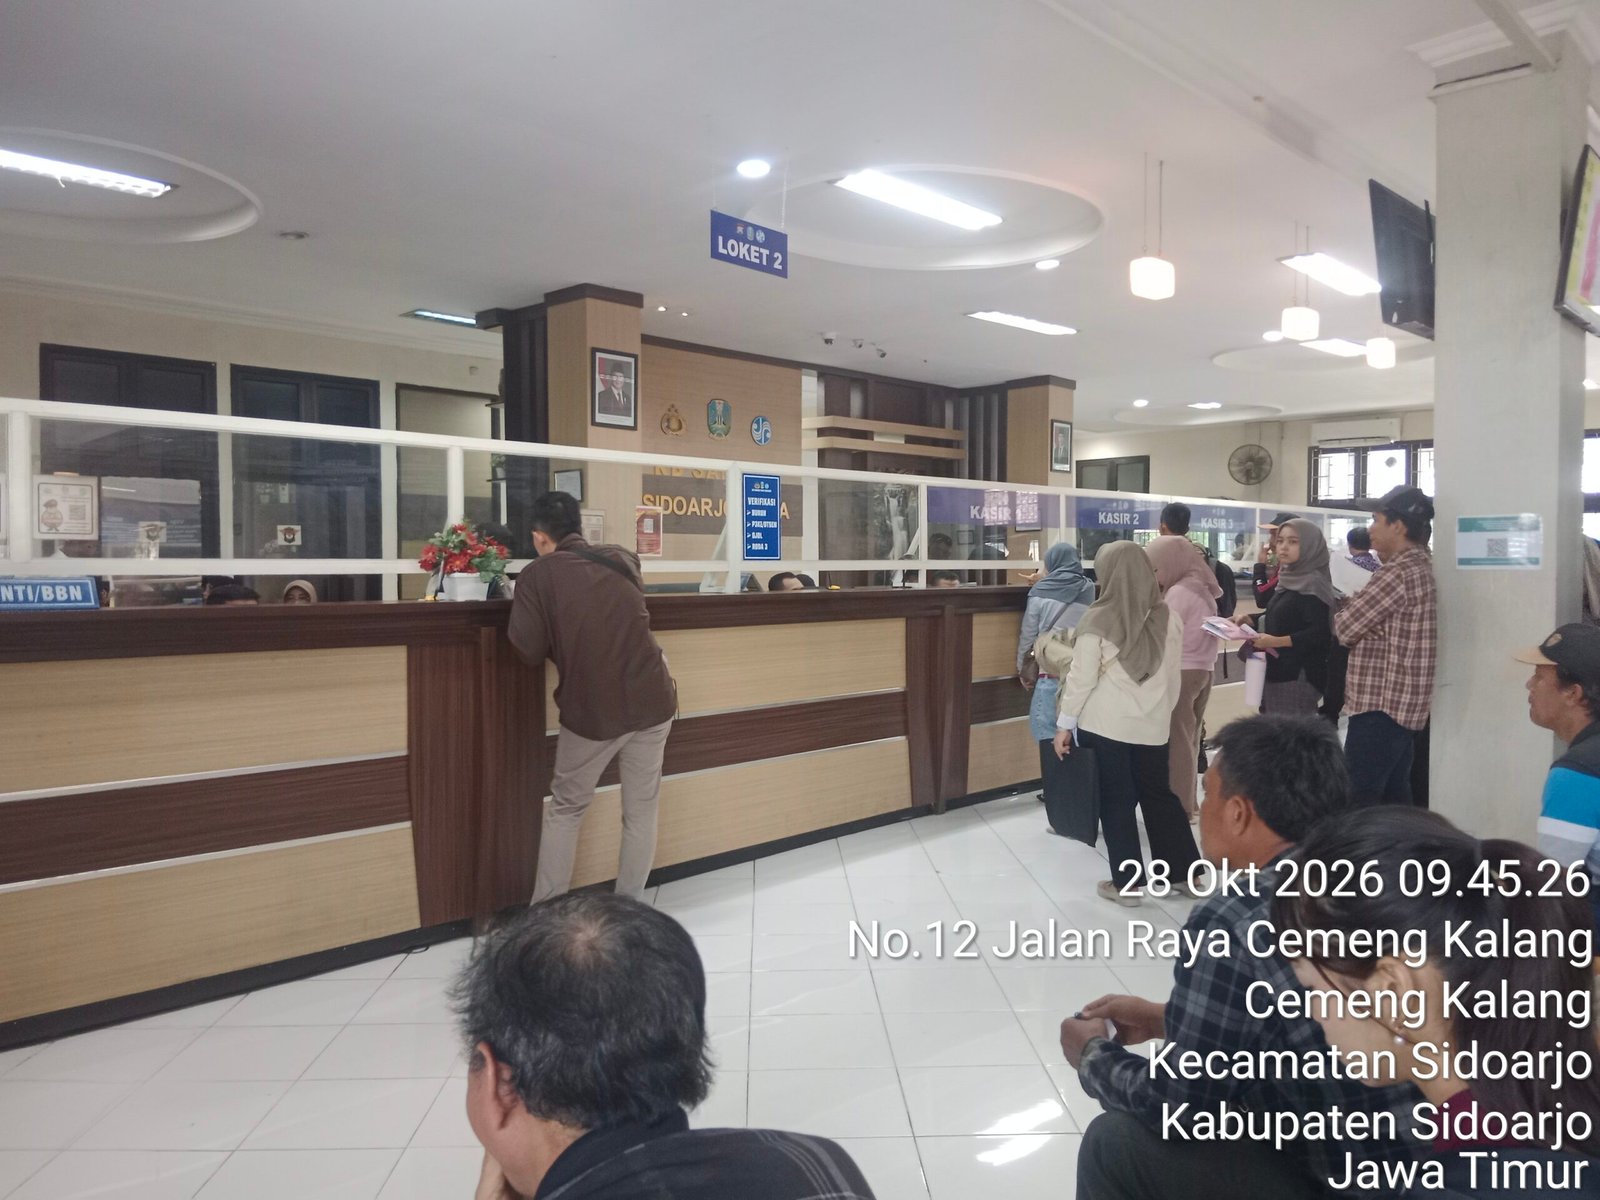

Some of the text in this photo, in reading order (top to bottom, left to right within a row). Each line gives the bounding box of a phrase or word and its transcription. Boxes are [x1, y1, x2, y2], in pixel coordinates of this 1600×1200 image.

[718, 235, 783, 270] LOKET 2
[643, 494, 727, 517] SIDOARJ
[748, 497, 776, 507] VERIFIKASI
[970, 505, 1011, 520] KASIR
[1098, 512, 1140, 525] KASIR 2
[1201, 517, 1234, 529] KASIR 3
[0, 585, 83, 603] NTI/BBN
